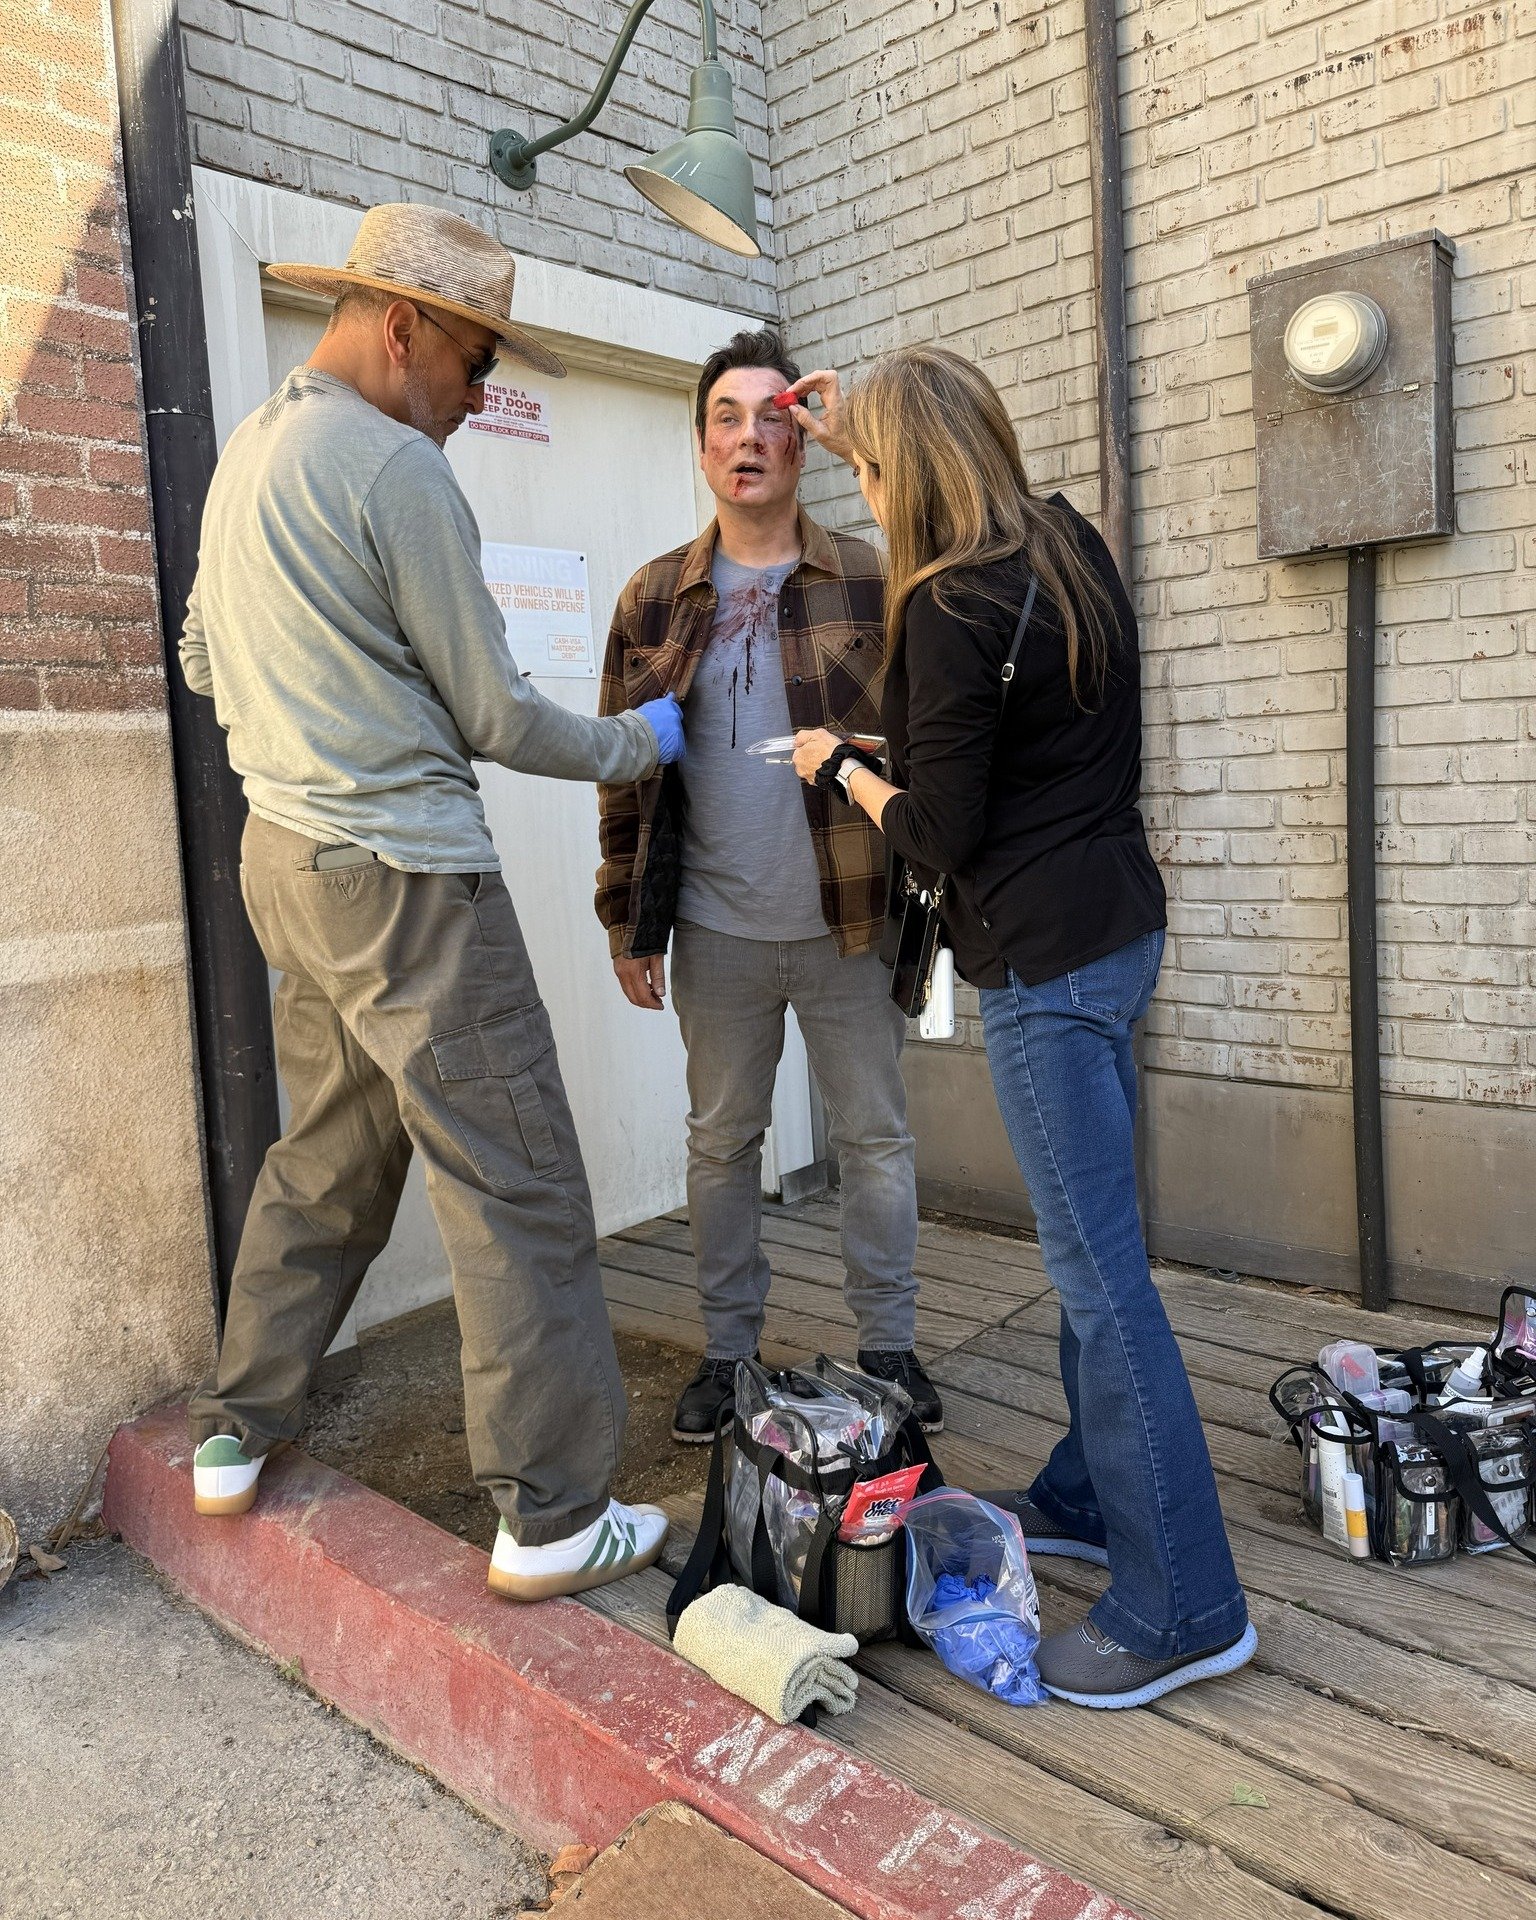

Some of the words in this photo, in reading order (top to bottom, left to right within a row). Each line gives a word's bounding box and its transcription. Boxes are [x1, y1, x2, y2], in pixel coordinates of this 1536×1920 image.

[487, 384, 508, 396] THIS
[510, 389, 518, 398] IS
[520, 391, 527, 400] A
[484, 393, 502, 405] RE
[506, 397, 542, 413] DOOR
[484, 404, 500, 413] EEP
[502, 408, 540, 422] CLOSED!
[480, 423, 490, 431] NOT
[491, 425, 509, 434] BLOCK
[518, 430, 532, 439] KEEP
[483, 550, 572, 582] ARNING
[514, 584, 553, 599] VEHICLES
[554, 588, 574, 600] WILL
[575, 590, 586, 601] BE
[500, 597, 512, 608] AT
[514, 598, 550, 611] OWNERS
[552, 600, 586, 614] EXPENSE
[871, 1498, 902, 1509] Wet
[695, 1714, 863, 1826] NO
[877, 1810, 1145, 1920] PA
